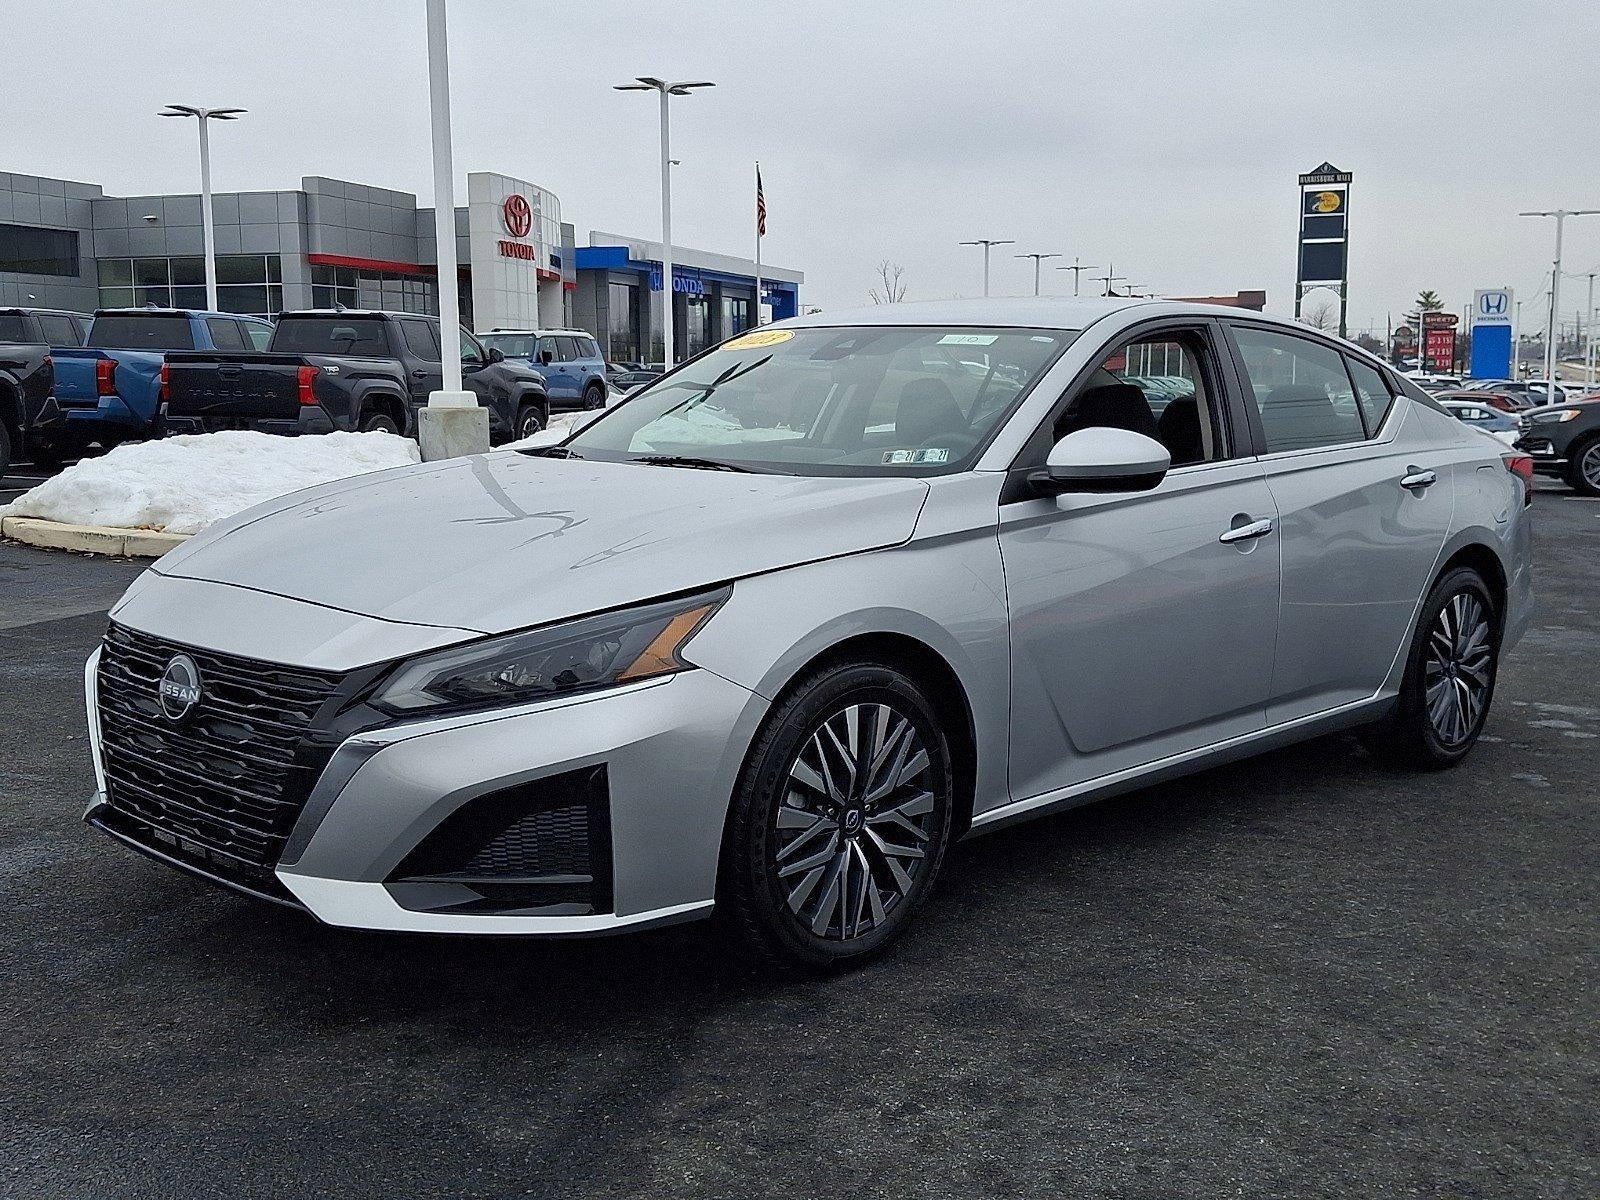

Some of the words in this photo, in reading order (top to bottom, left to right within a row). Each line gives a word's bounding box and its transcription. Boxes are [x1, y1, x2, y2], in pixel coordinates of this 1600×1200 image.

[498, 240, 535, 261] TOYOTA
[673, 276, 704, 294] ONDA
[189, 388, 278, 398] TACOMA
[162, 683, 199, 701] ISSAN
